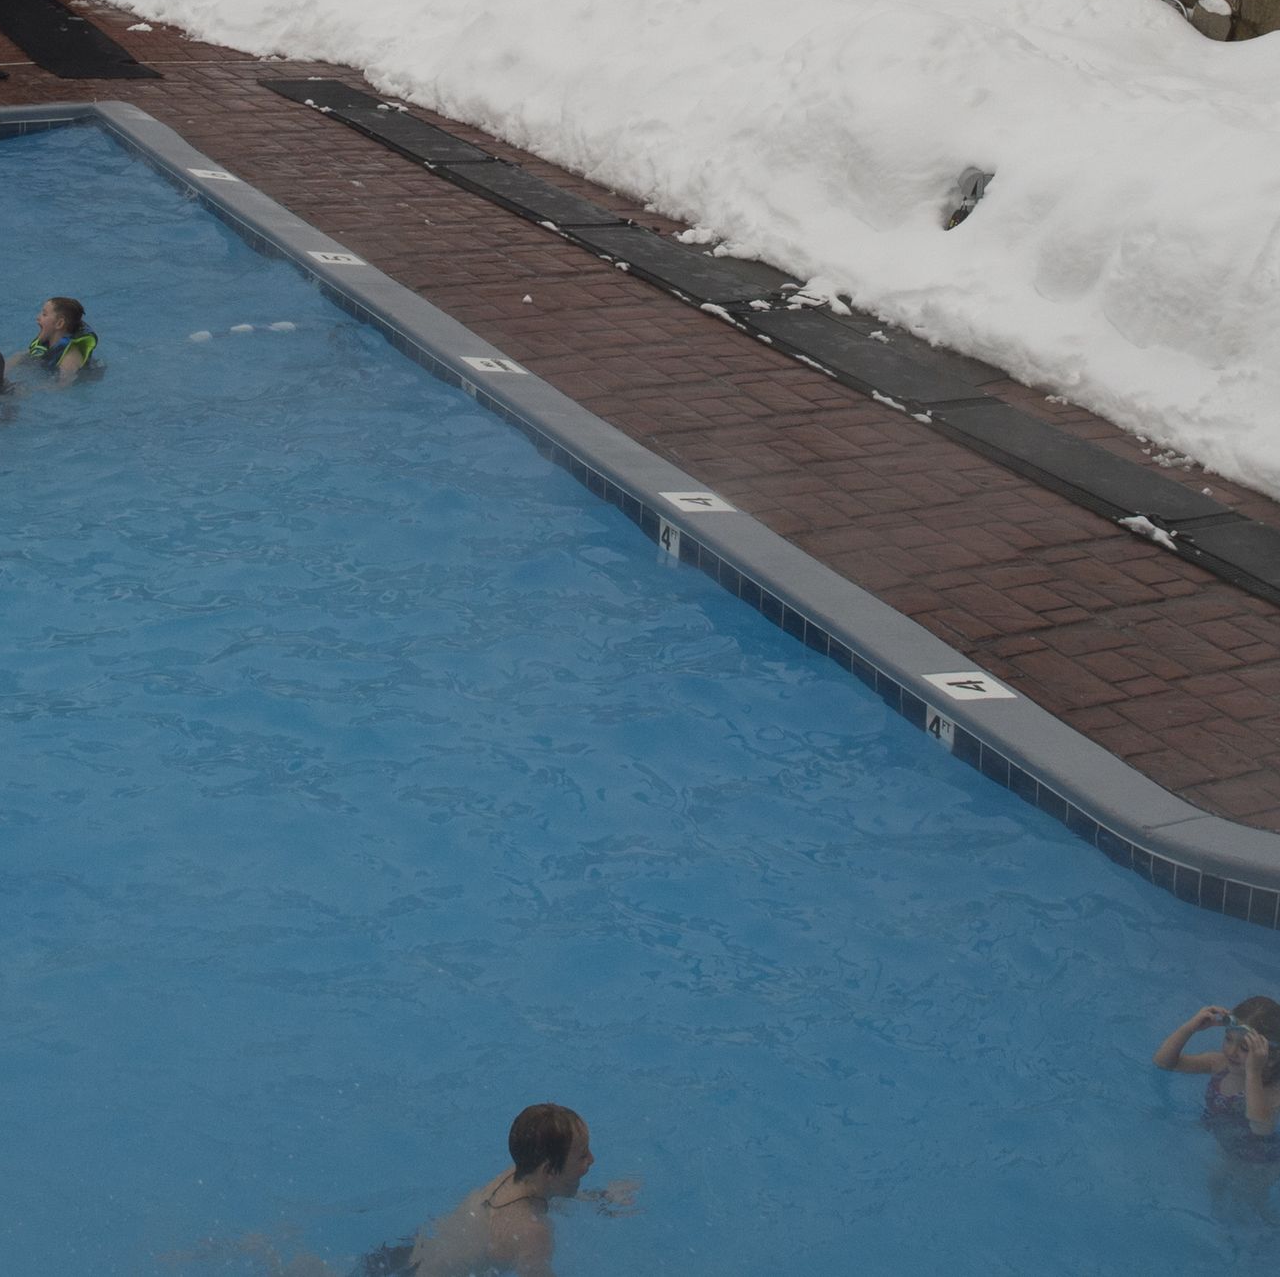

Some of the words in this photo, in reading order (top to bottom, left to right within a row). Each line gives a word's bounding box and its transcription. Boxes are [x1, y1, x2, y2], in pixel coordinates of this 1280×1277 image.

[321, 254, 351, 262] 5
[679, 497, 713, 507] 4
[661, 525, 671, 551] 4
[946, 680, 987, 693] 4
[928, 714, 941, 739] 4
